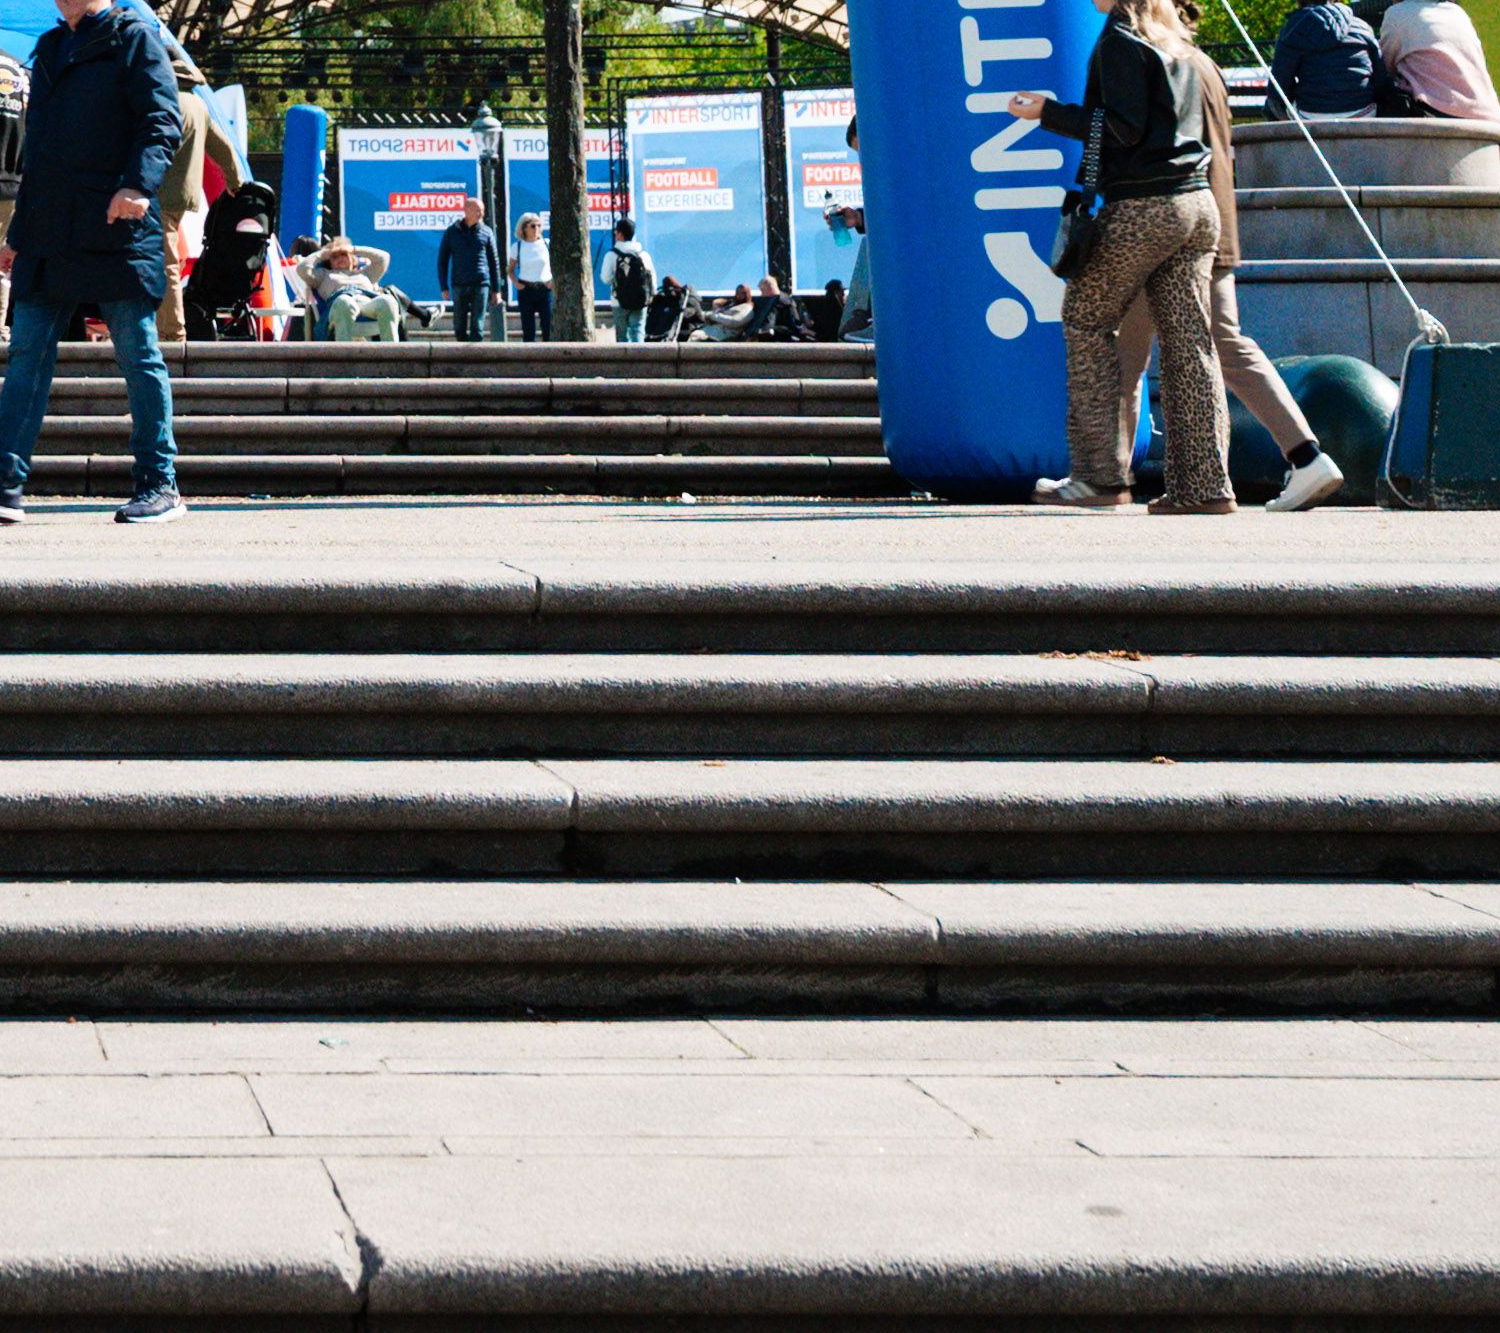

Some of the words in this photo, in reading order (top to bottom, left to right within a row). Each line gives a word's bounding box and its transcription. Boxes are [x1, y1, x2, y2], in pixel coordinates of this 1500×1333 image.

[651, 106, 752, 125] INTERSPORT
[646, 170, 715, 187] FOOTBALL
[647, 192, 729, 208] EXPERIENCE
